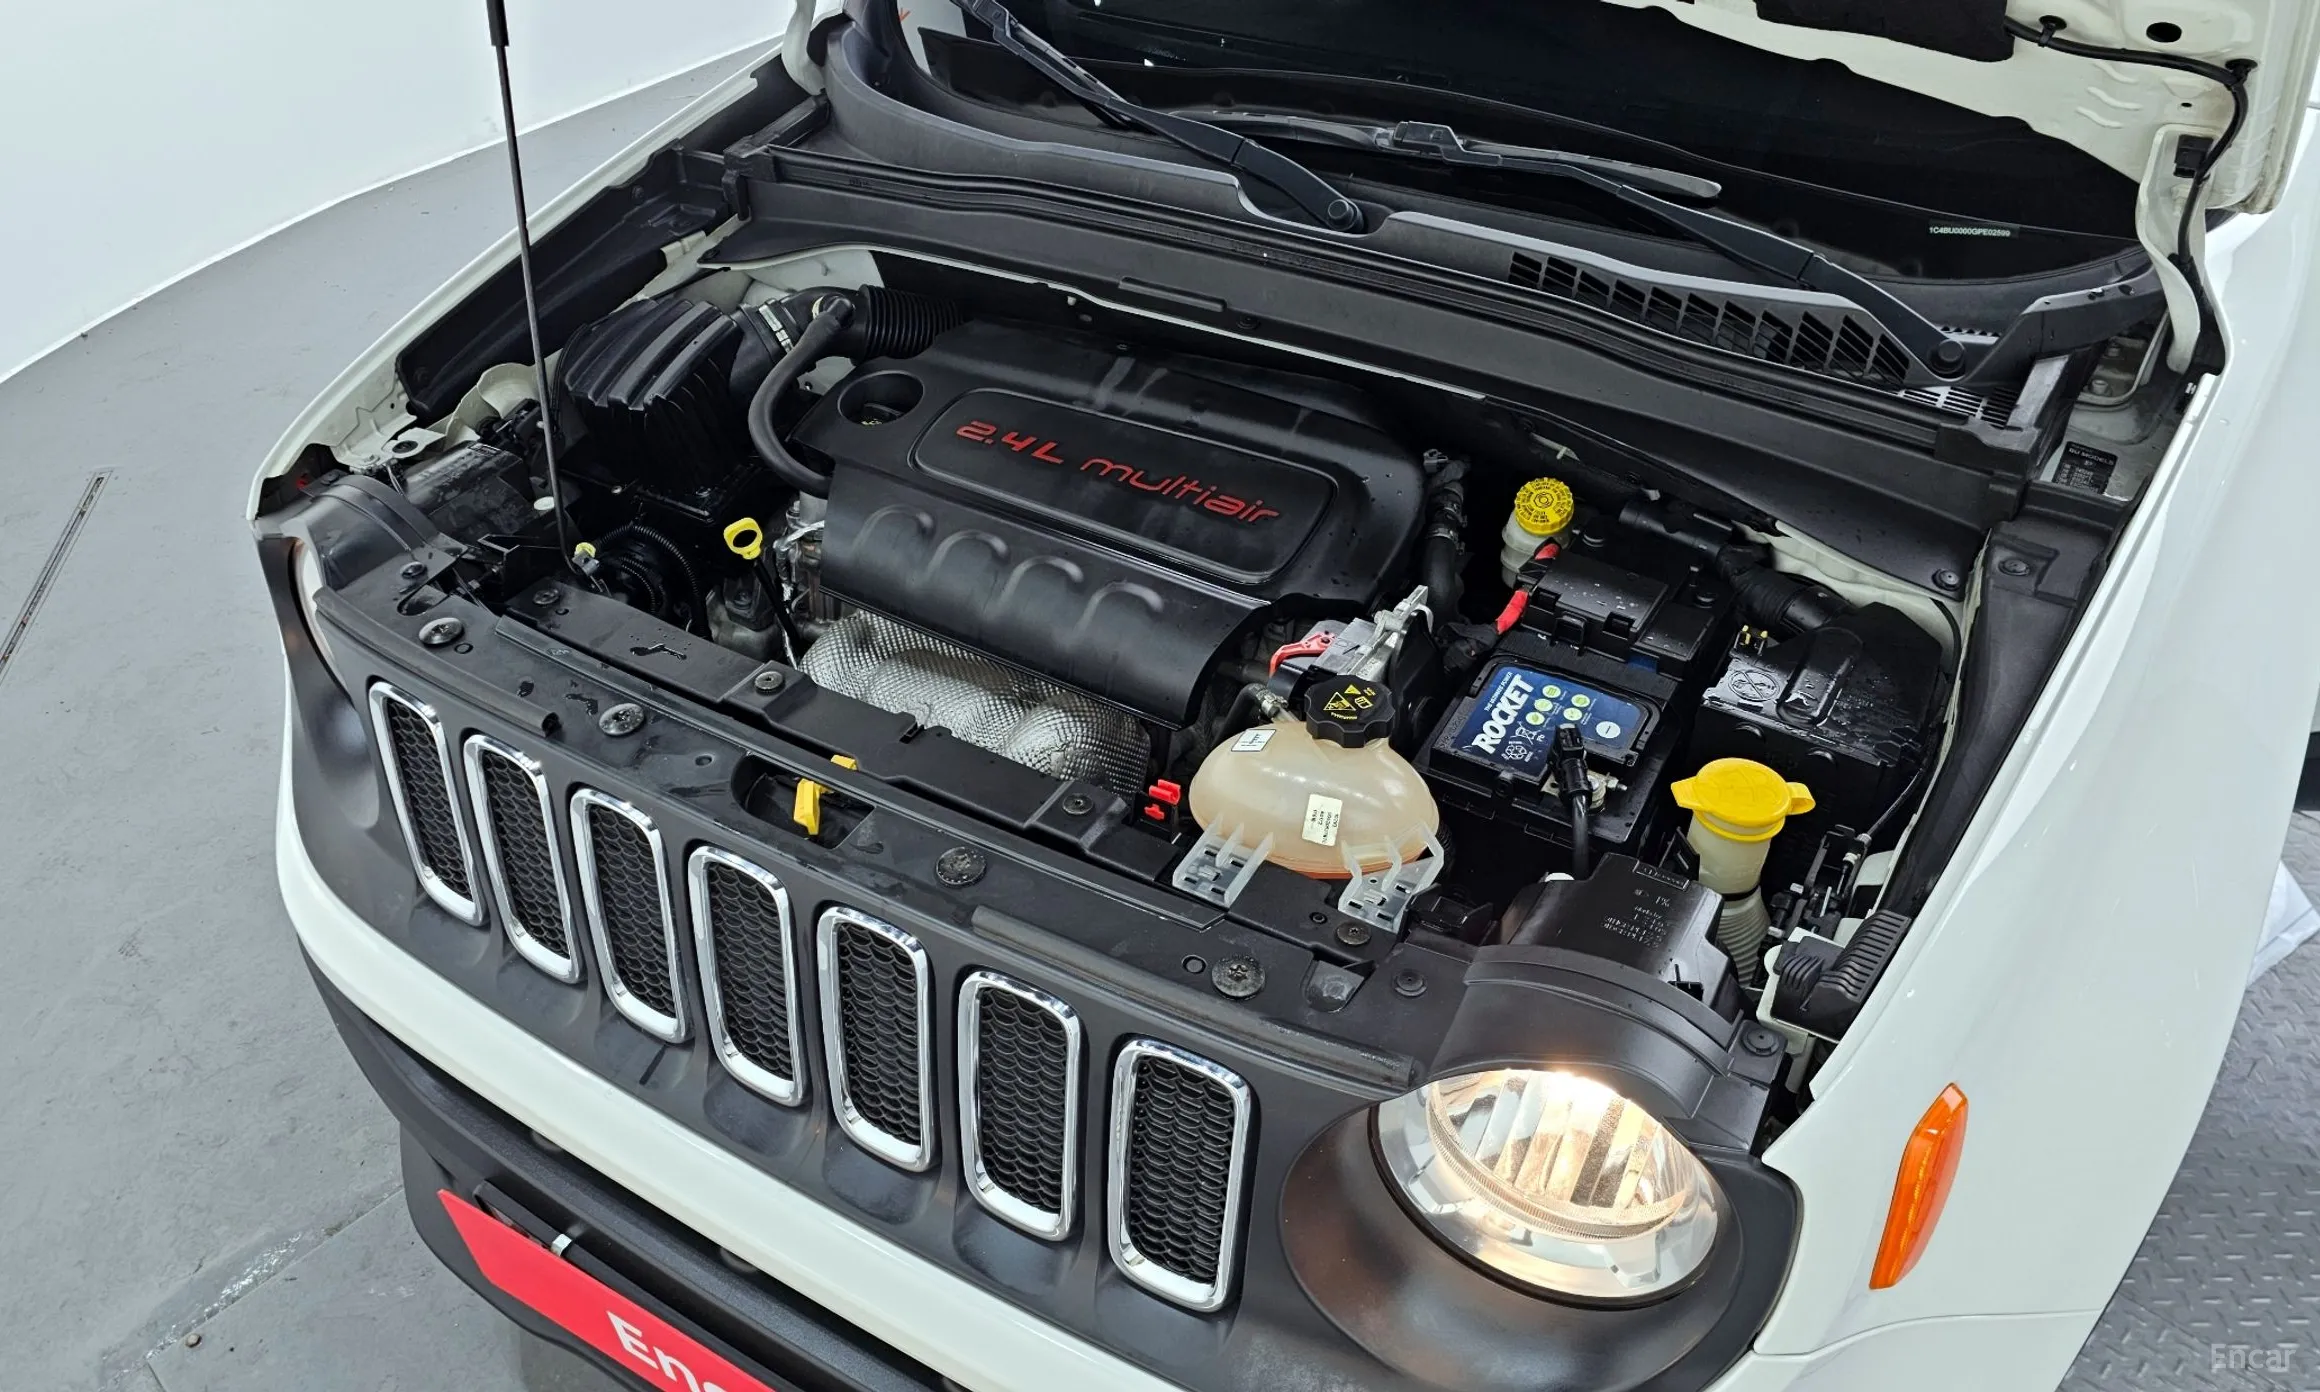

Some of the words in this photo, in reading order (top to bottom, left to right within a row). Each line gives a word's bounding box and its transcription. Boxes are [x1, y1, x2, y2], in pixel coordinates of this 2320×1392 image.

[956, 420, 1064, 465] 2.4L
[1080, 457, 1280, 523] multiair
[1472, 673, 1535, 755] ROCKET
[606, 1310, 728, 1392] En
